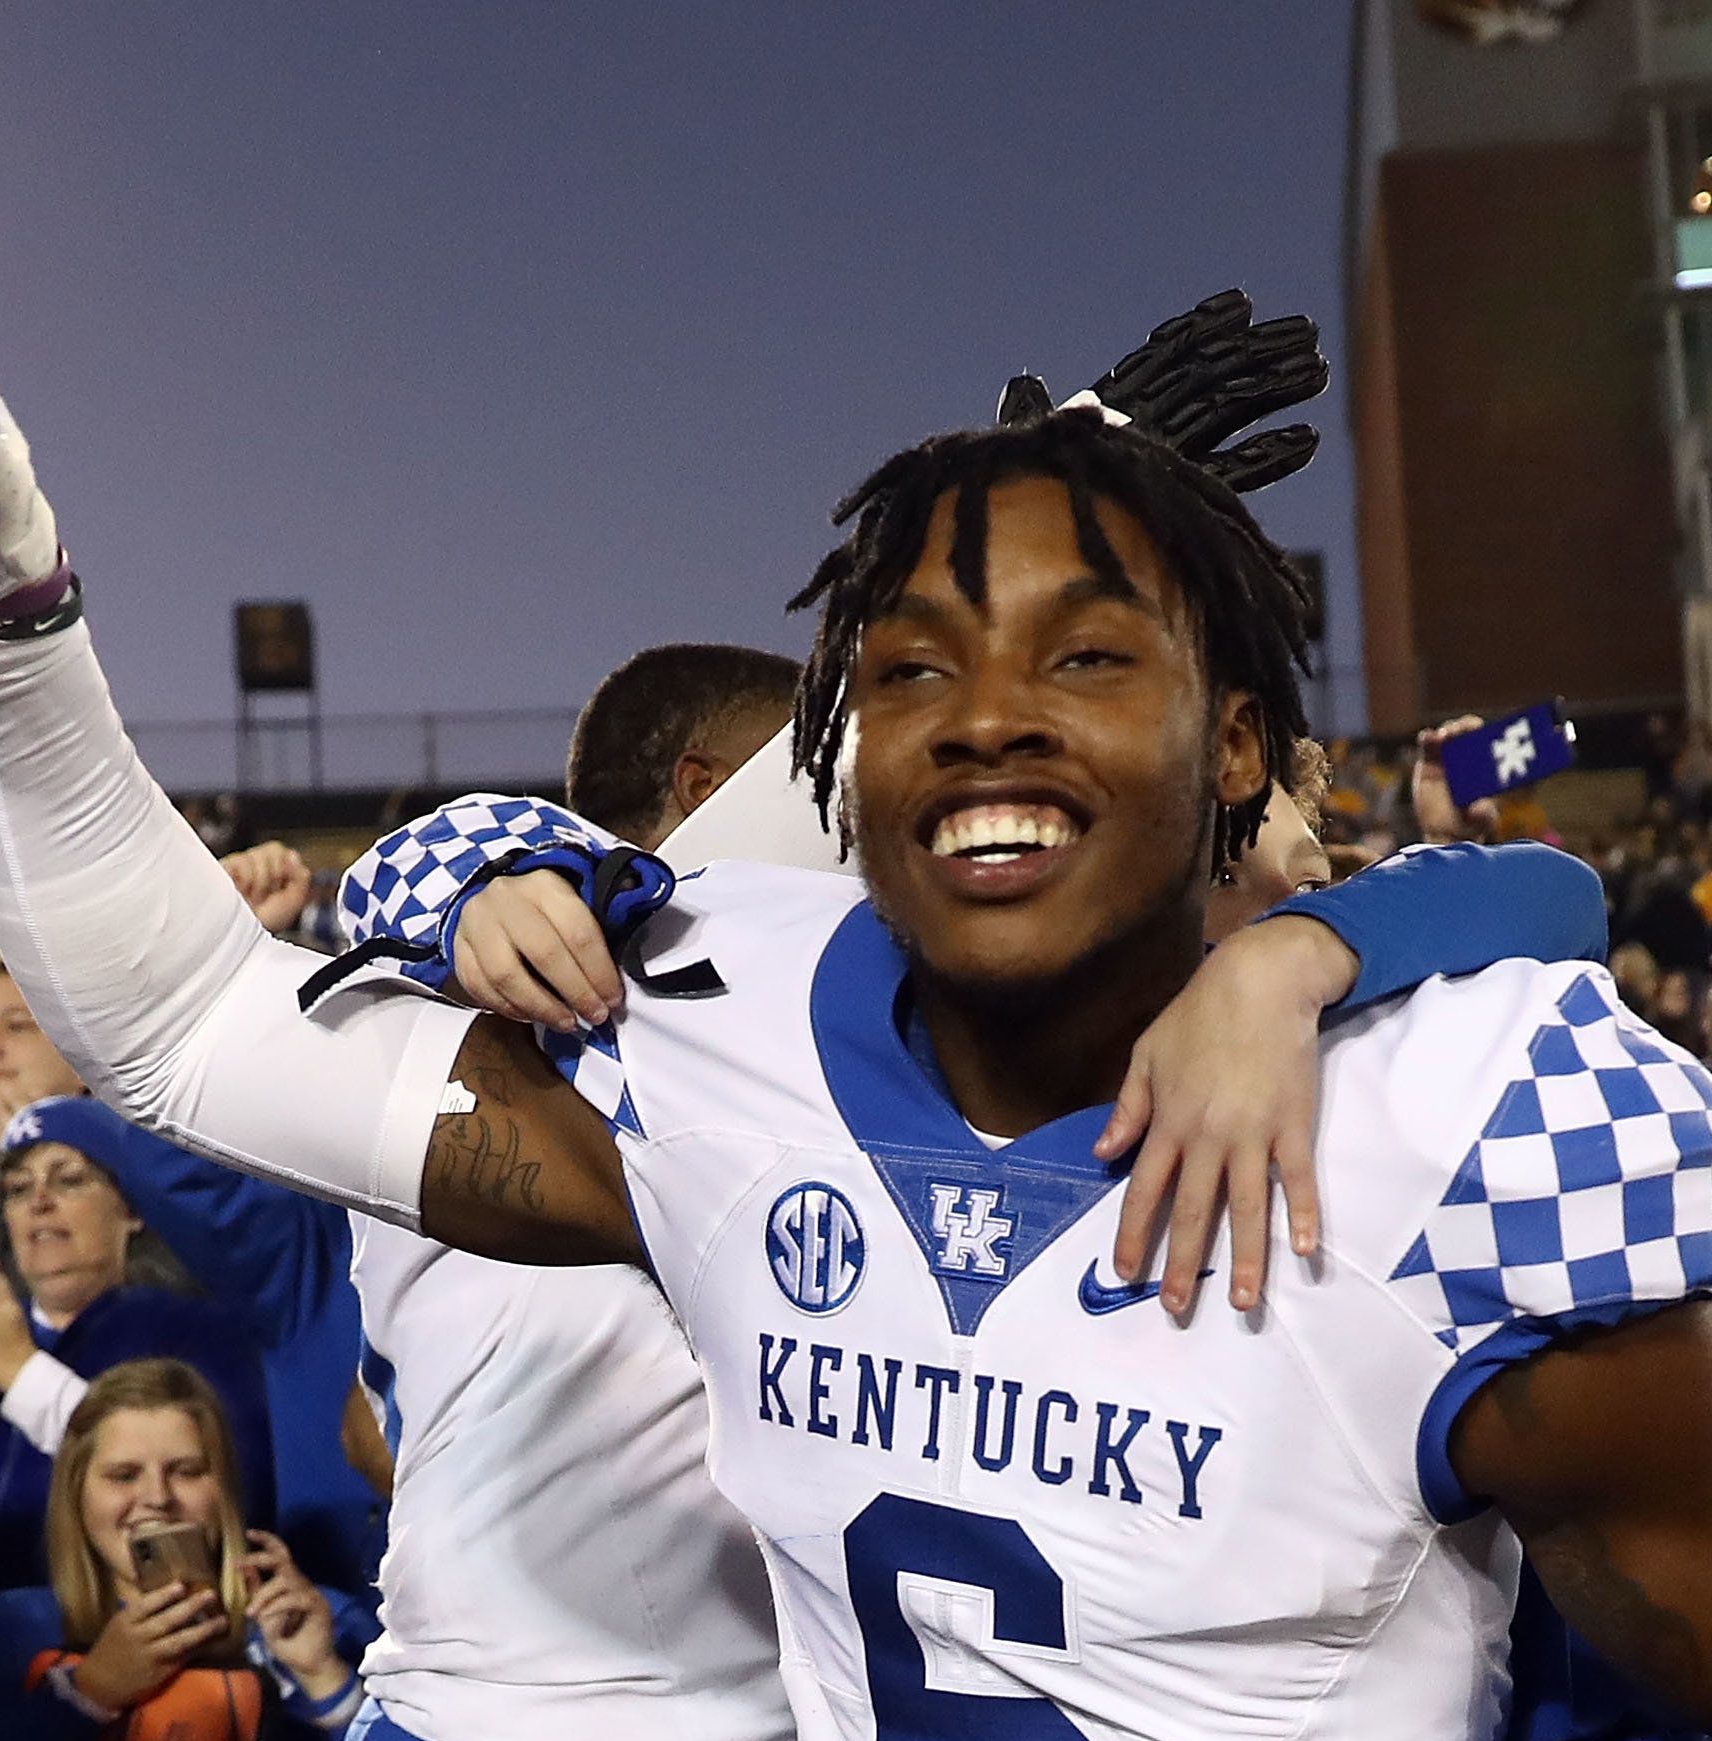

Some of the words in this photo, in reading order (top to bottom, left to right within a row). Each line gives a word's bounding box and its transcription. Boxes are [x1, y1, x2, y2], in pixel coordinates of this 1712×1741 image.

[770, 1188, 860, 1306] SEC
[928, 1182, 1014, 1277] UK
[757, 1332, 1223, 1520] KENTUCKY
